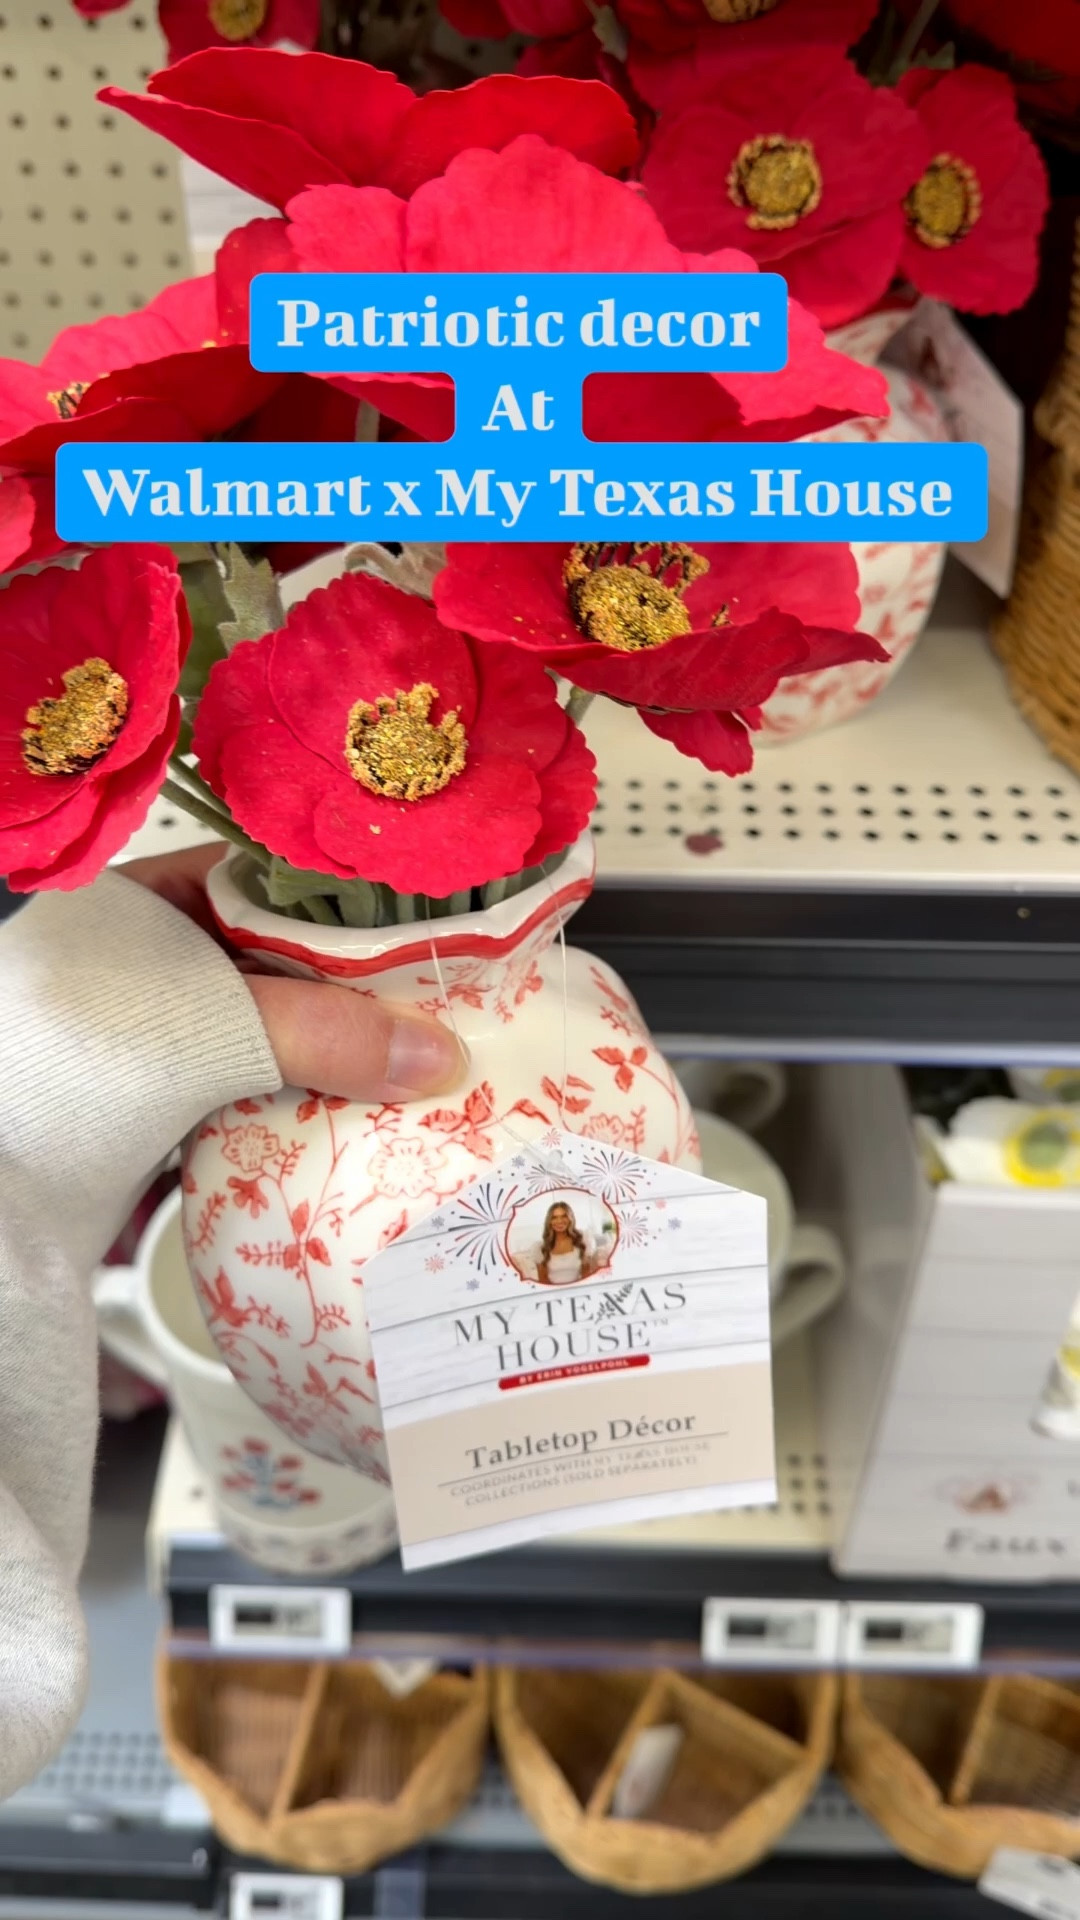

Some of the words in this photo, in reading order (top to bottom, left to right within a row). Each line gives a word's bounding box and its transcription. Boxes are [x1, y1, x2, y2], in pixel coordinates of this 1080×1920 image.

[453, 1306, 518, 1346] MY
[535, 1281, 687, 1328] TEXAS
[518, 1374, 534, 1386] BY
[536, 1368, 563, 1382] ERIN
[464, 1429, 598, 1469] Tabletop
[606, 1413, 697, 1442] Décor
[449, 1465, 551, 1498] COORDINATES
[553, 1456, 592, 1473] WITH
[464, 1476, 561, 1507] COLLECTIONS
